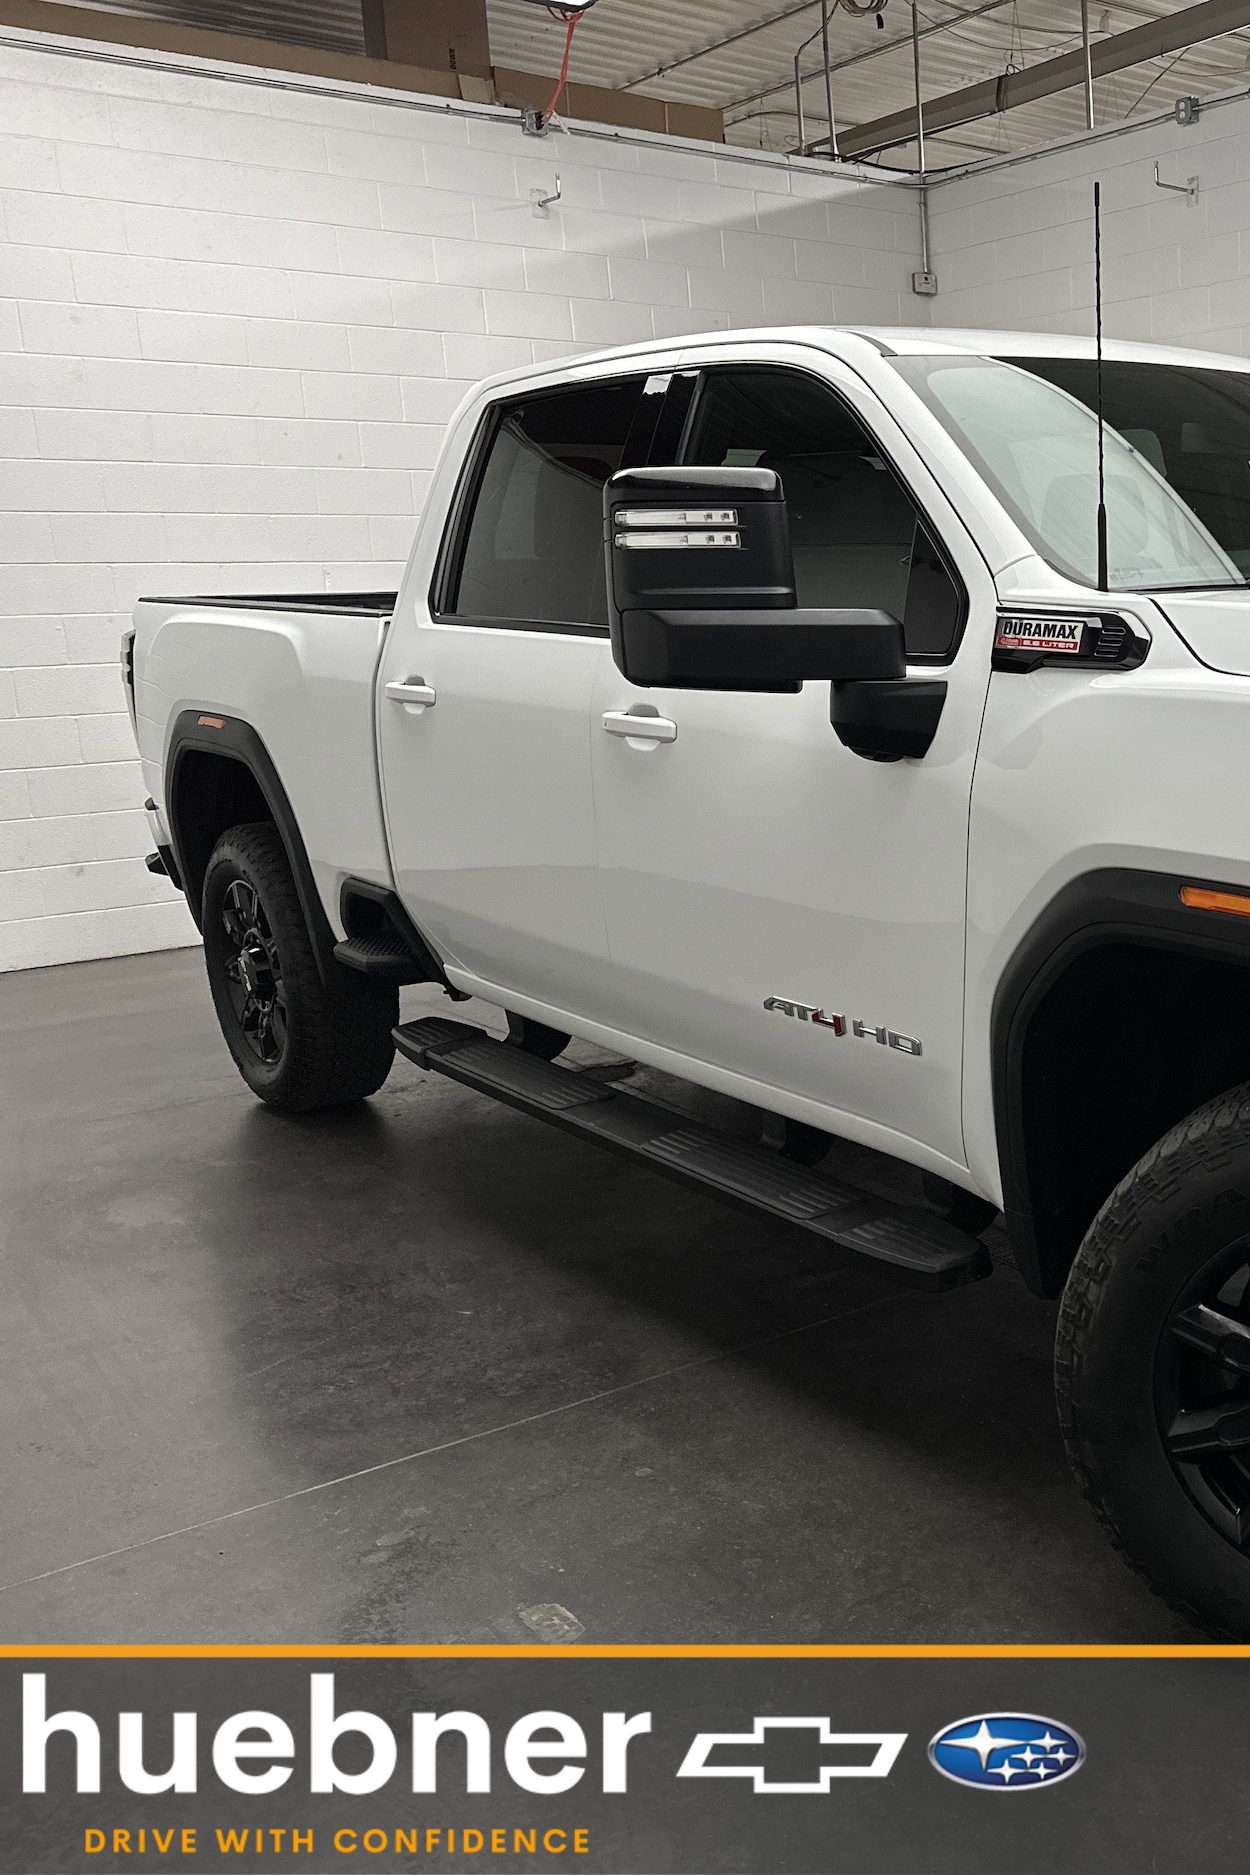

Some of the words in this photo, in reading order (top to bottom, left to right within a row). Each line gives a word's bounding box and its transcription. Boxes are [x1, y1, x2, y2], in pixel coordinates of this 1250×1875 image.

[1002, 620, 1078, 640] DURAMAX
[1042, 640, 1075, 649] LITER
[763, 995, 847, 1037] AT4
[852, 1018, 923, 1056] HD
